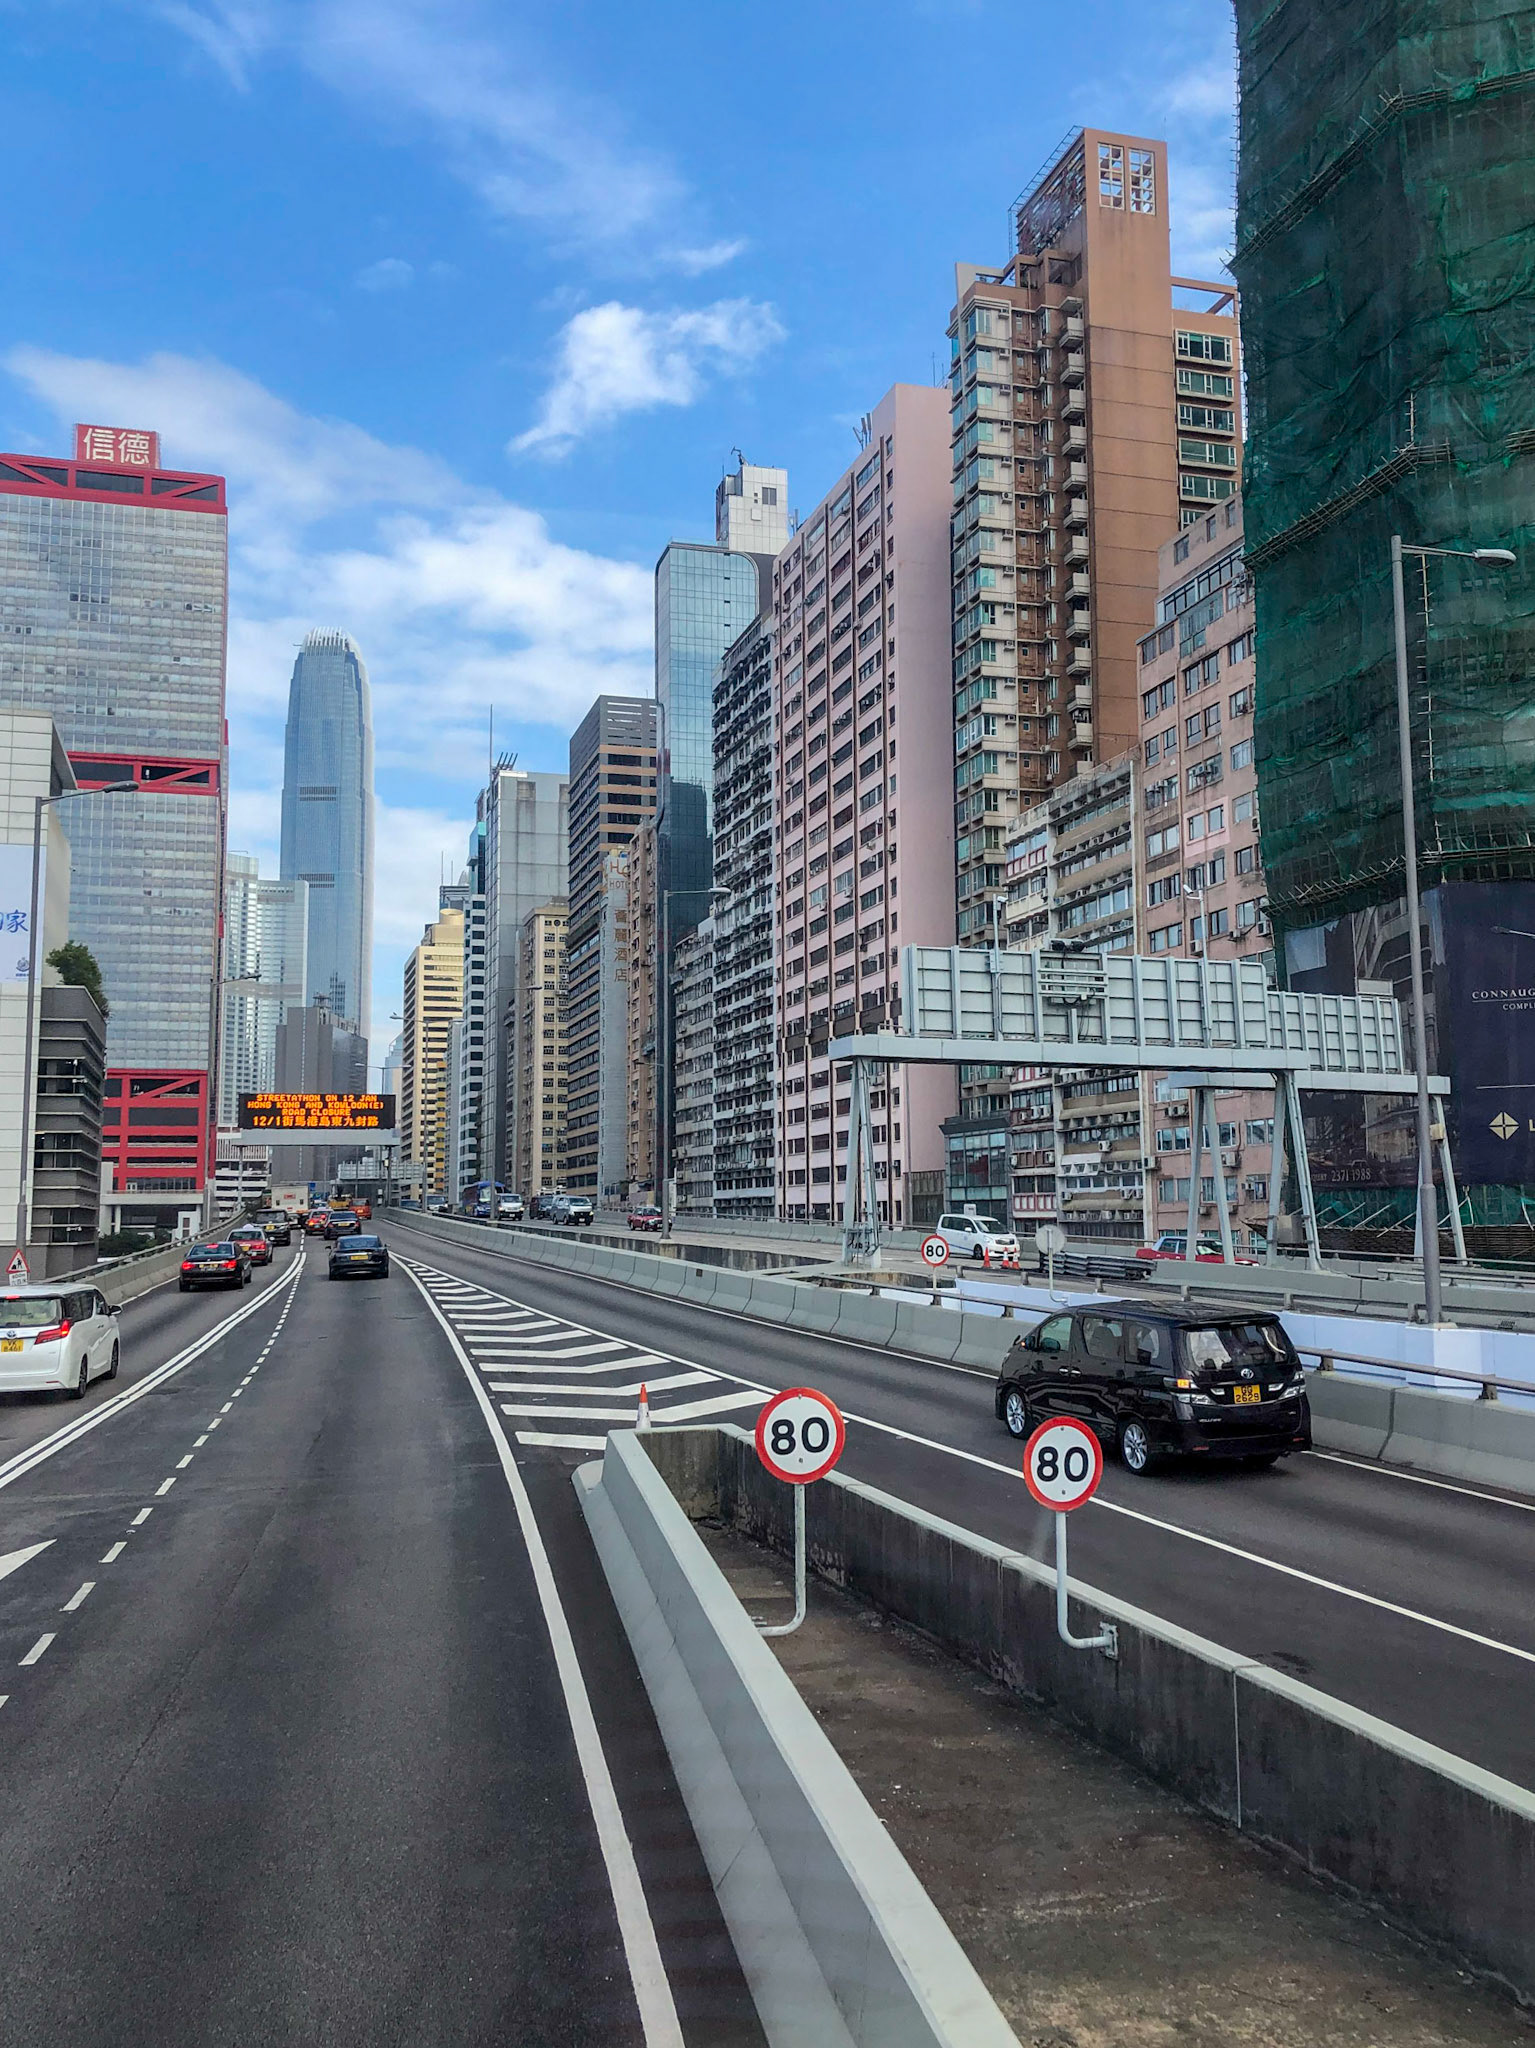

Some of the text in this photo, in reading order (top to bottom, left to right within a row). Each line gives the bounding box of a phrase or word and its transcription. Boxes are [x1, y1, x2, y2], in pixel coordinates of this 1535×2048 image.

[83, 428, 150, 465] 信德
[0, 908, 29, 934] 家
[1503, 1002, 1535, 1011] COMPL
[256, 1094, 378, 1102] STREETATHON ON 12 JAN
[247, 1101, 271, 1109] HONG
[276, 1101, 300, 1109] KONG
[305, 1101, 323, 1109] AND
[282, 1108, 351, 1116] ROAD CLOSURE
[925, 1245, 945, 1257] 80
[1241, 1385, 1253, 1394] GG
[1235, 1393, 1260, 1403] 2629
[770, 1416, 830, 1456] 80
[1036, 1446, 1090, 1483] 80
